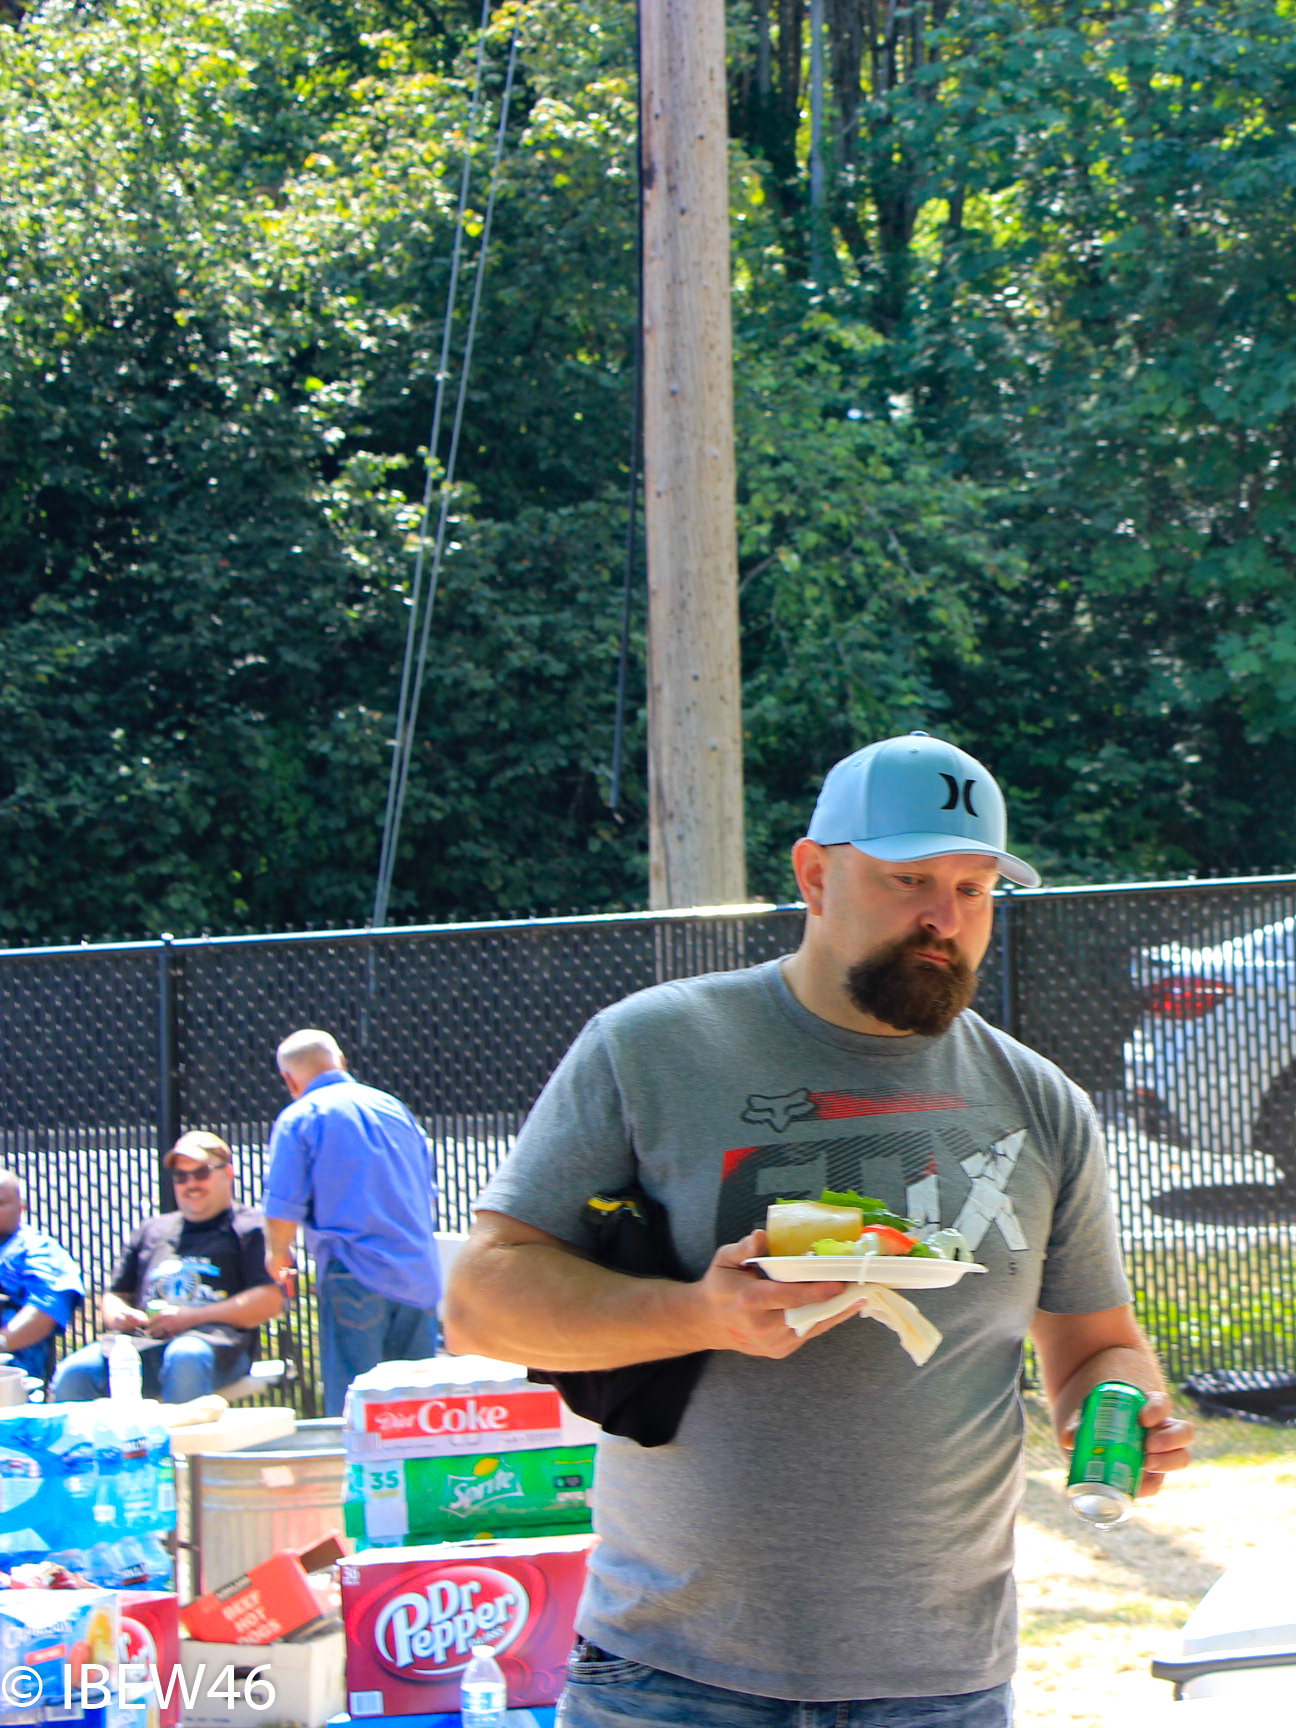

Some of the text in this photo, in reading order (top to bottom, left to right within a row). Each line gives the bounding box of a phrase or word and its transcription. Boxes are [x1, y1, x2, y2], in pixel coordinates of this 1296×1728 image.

[416, 1399, 510, 1434] Coke
[369, 1469, 399, 1490] 35
[426, 1579, 482, 1625] Dr
[375, 1592, 519, 1668] Pepper
